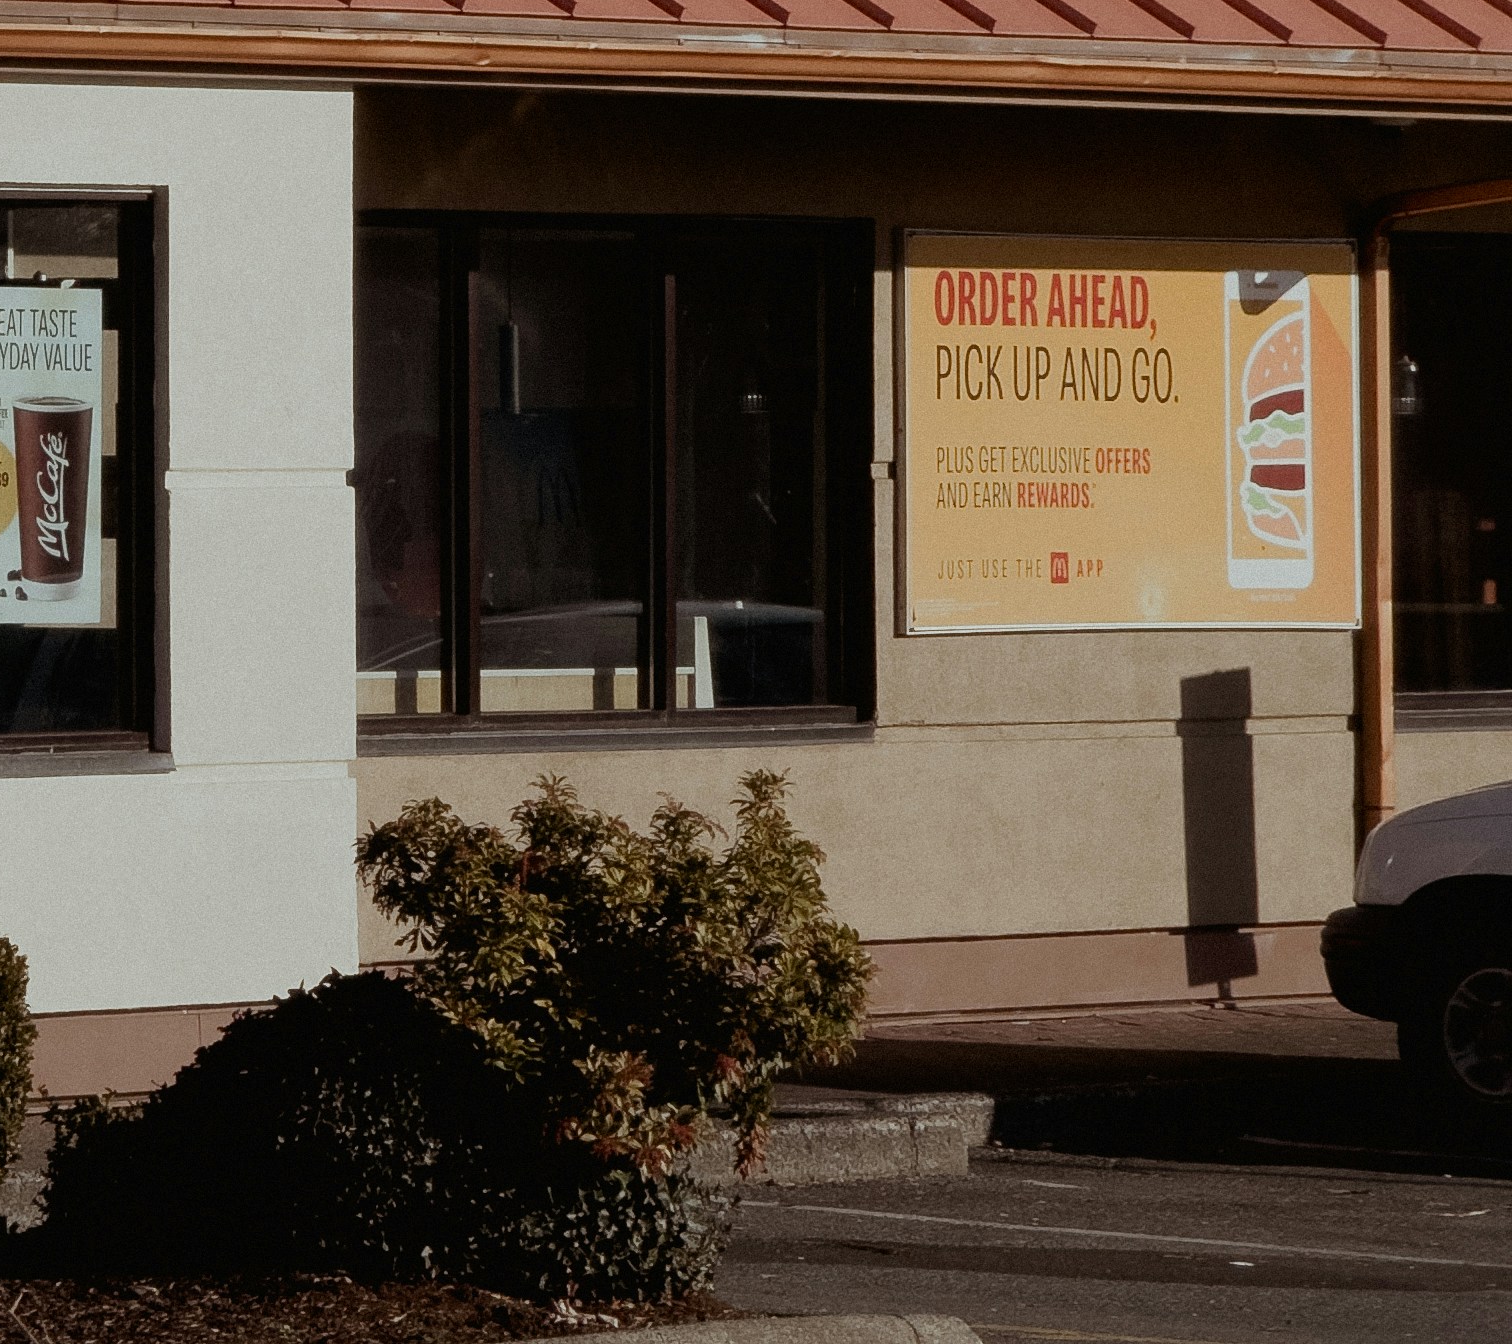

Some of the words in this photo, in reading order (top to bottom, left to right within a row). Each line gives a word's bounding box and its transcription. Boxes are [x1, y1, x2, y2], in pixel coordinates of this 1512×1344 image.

[934, 270, 1039, 327] ORDER
[1045, 272, 1157, 341] AHEAD,
[30, 308, 78, 338] TASTE
[43, 343, 93, 372] VALUE
[936, 344, 1004, 401] PICK
[1013, 345, 1051, 402] UP
[1060, 346, 1122, 402] AND
[1131, 347, 1179, 404] GO.
[936, 446, 974, 474] PLUS
[978, 445, 1007, 473] GET
[1011, 446, 1091, 474] EXCLUSIVE
[1095, 447, 1151, 475] OFFERS
[36, 431, 70, 562] McCafé
[936, 481, 968, 509] AND
[973, 481, 1012, 509] EARN
[937, 559, 974, 580] JUST
[981, 558, 1008, 579] USE
[1016, 558, 1042, 579] THE
[1076, 559, 1104, 578] APP
